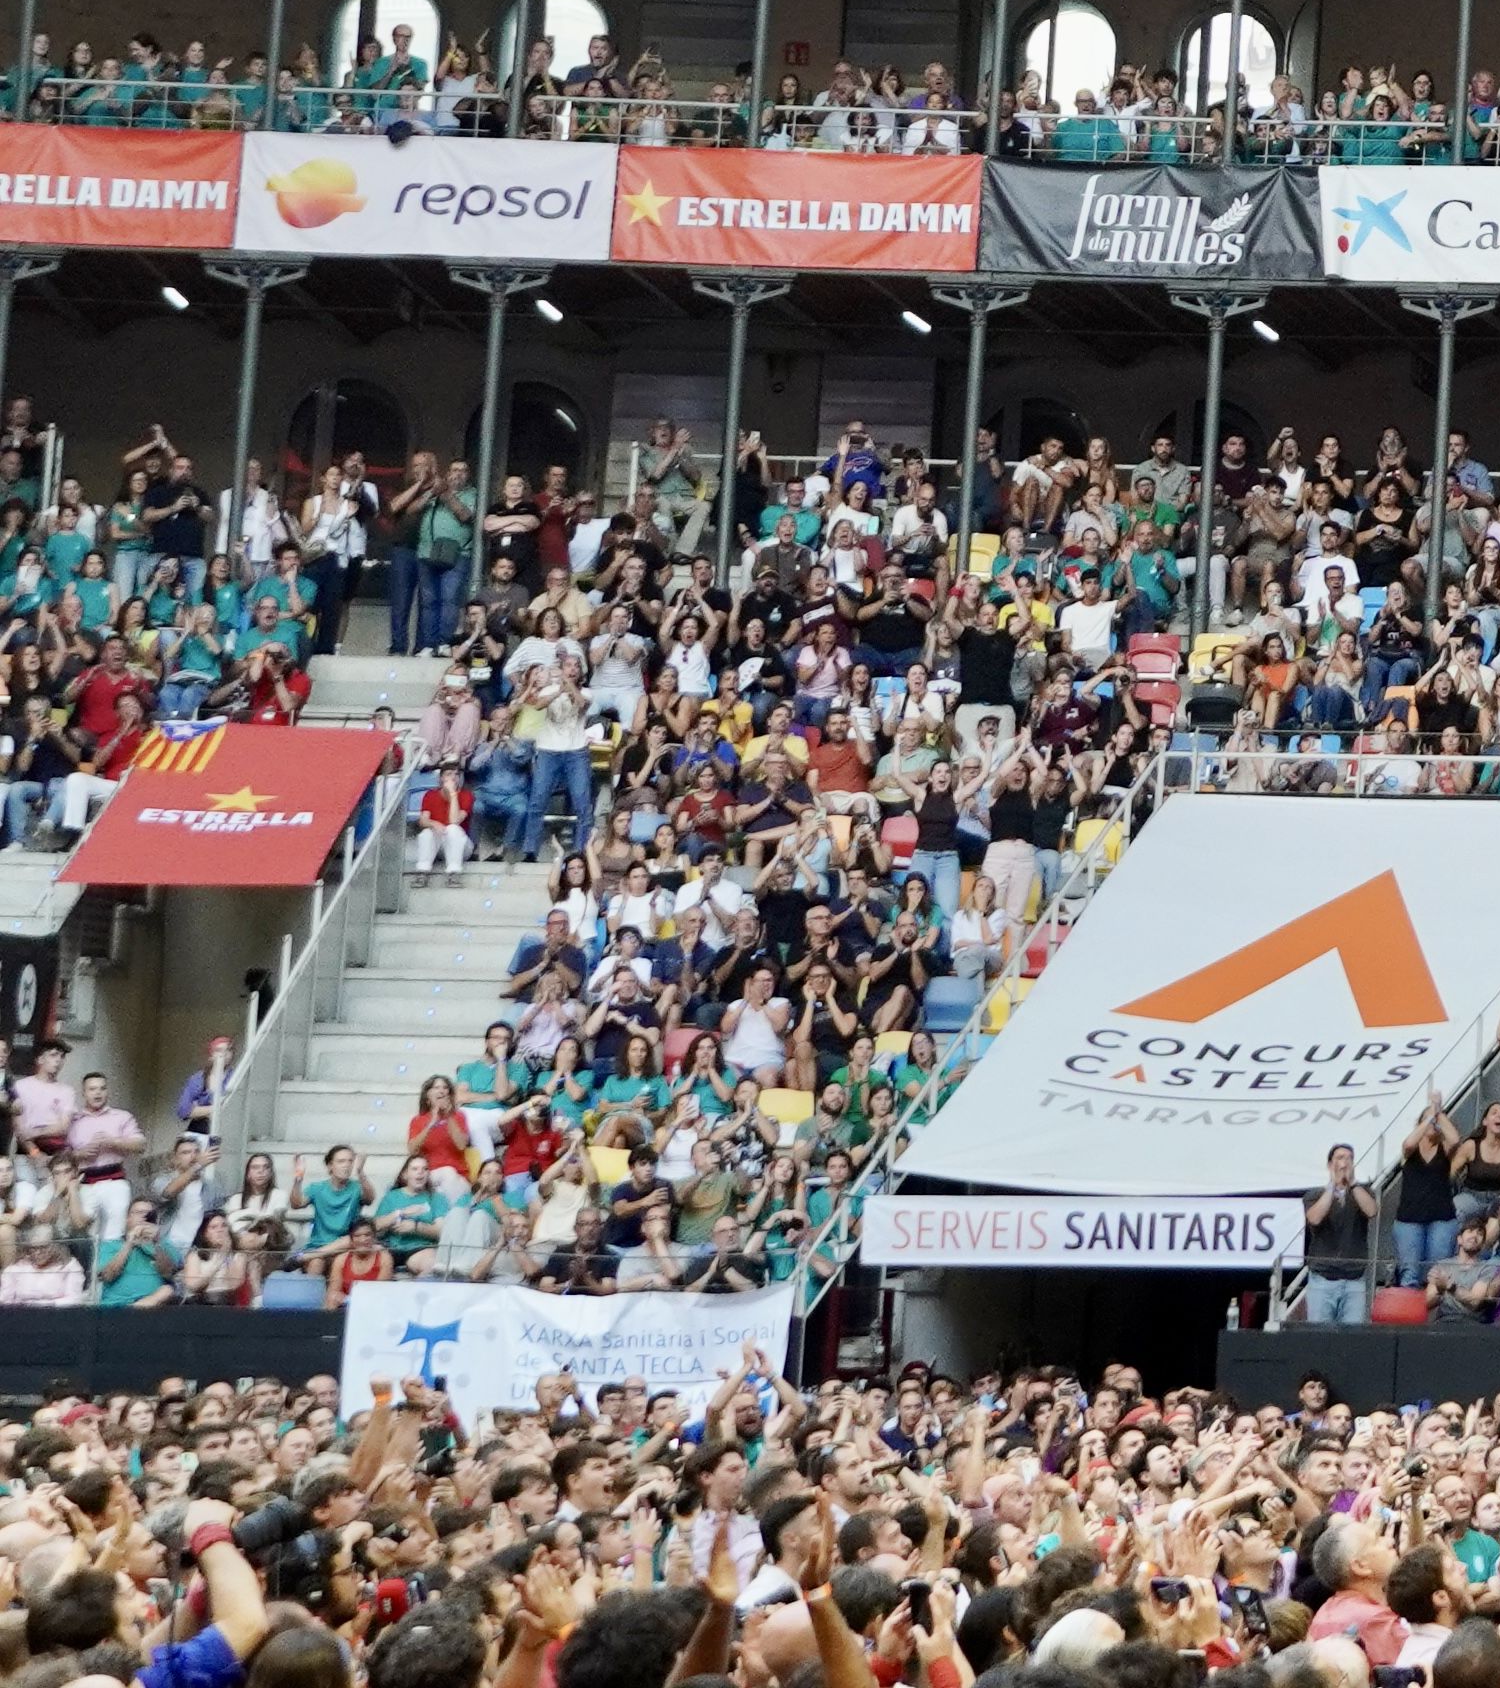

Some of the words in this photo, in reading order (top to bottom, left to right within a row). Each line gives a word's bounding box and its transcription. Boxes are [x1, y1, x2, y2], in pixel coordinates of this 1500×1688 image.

[108, 178, 229, 210] DAMM
[393, 179, 592, 225] repsol
[677, 196, 854, 232] ESTRELLA
[857, 202, 973, 234] DAMM
[1065, 174, 1170, 261] forn
[1104, 196, 1246, 265] nulles
[1087, 229, 1111, 252] de
[137, 807, 315, 826] ESTRELLA
[1085, 1028, 1433, 1064] CONCURS
[1064, 1054, 1414, 1090] CASTELLS
[1037, 1089, 1383, 1127] TARRAGONA
[891, 1210, 1049, 1250] SERVEIS
[1064, 1211, 1276, 1252] SANITARIS
[521, 1323, 592, 1349] XARXA
[551, 1353, 627, 1376] SANTA
[635, 1355, 705, 1375] TECLA
